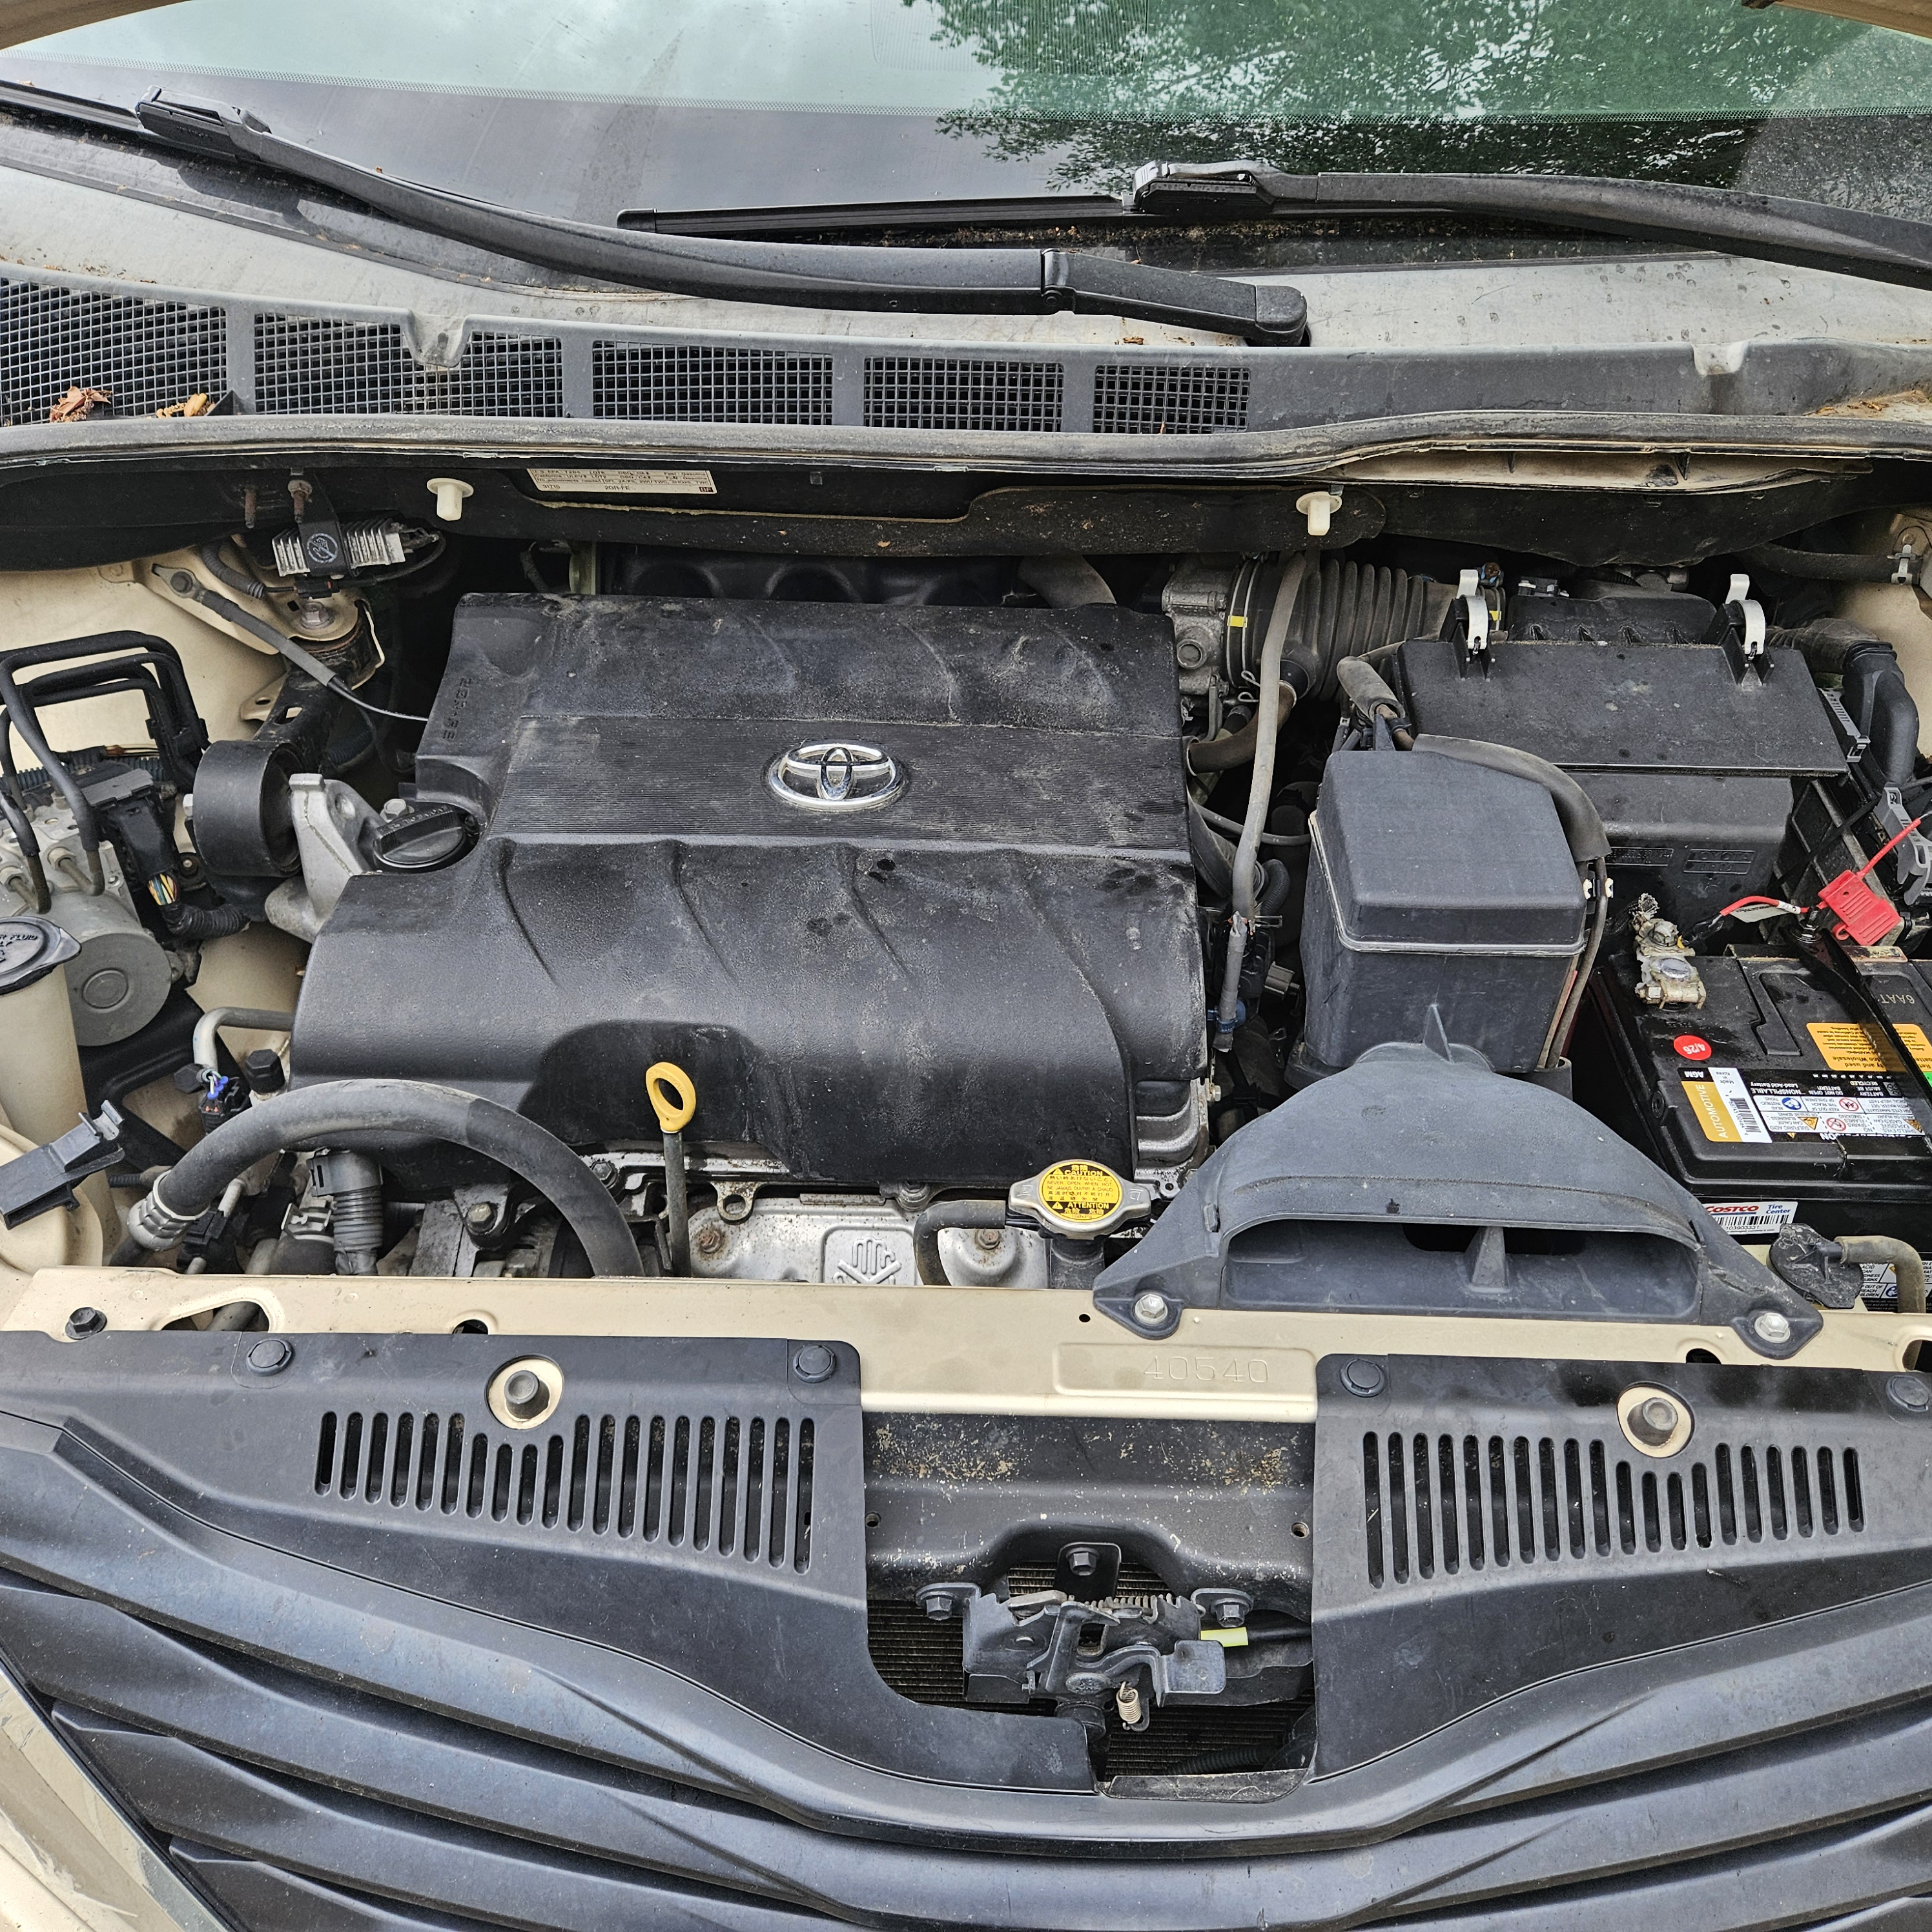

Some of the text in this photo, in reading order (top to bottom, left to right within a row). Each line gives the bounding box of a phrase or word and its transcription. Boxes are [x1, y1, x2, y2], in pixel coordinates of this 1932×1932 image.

[1879, 994, 1915, 1004] 6AAT
[1683, 1043, 1706, 1054] 4/26
[1695, 1084, 1729, 1138] AUTOMOTIVE
[1143, 1355, 1269, 1382] 40540
